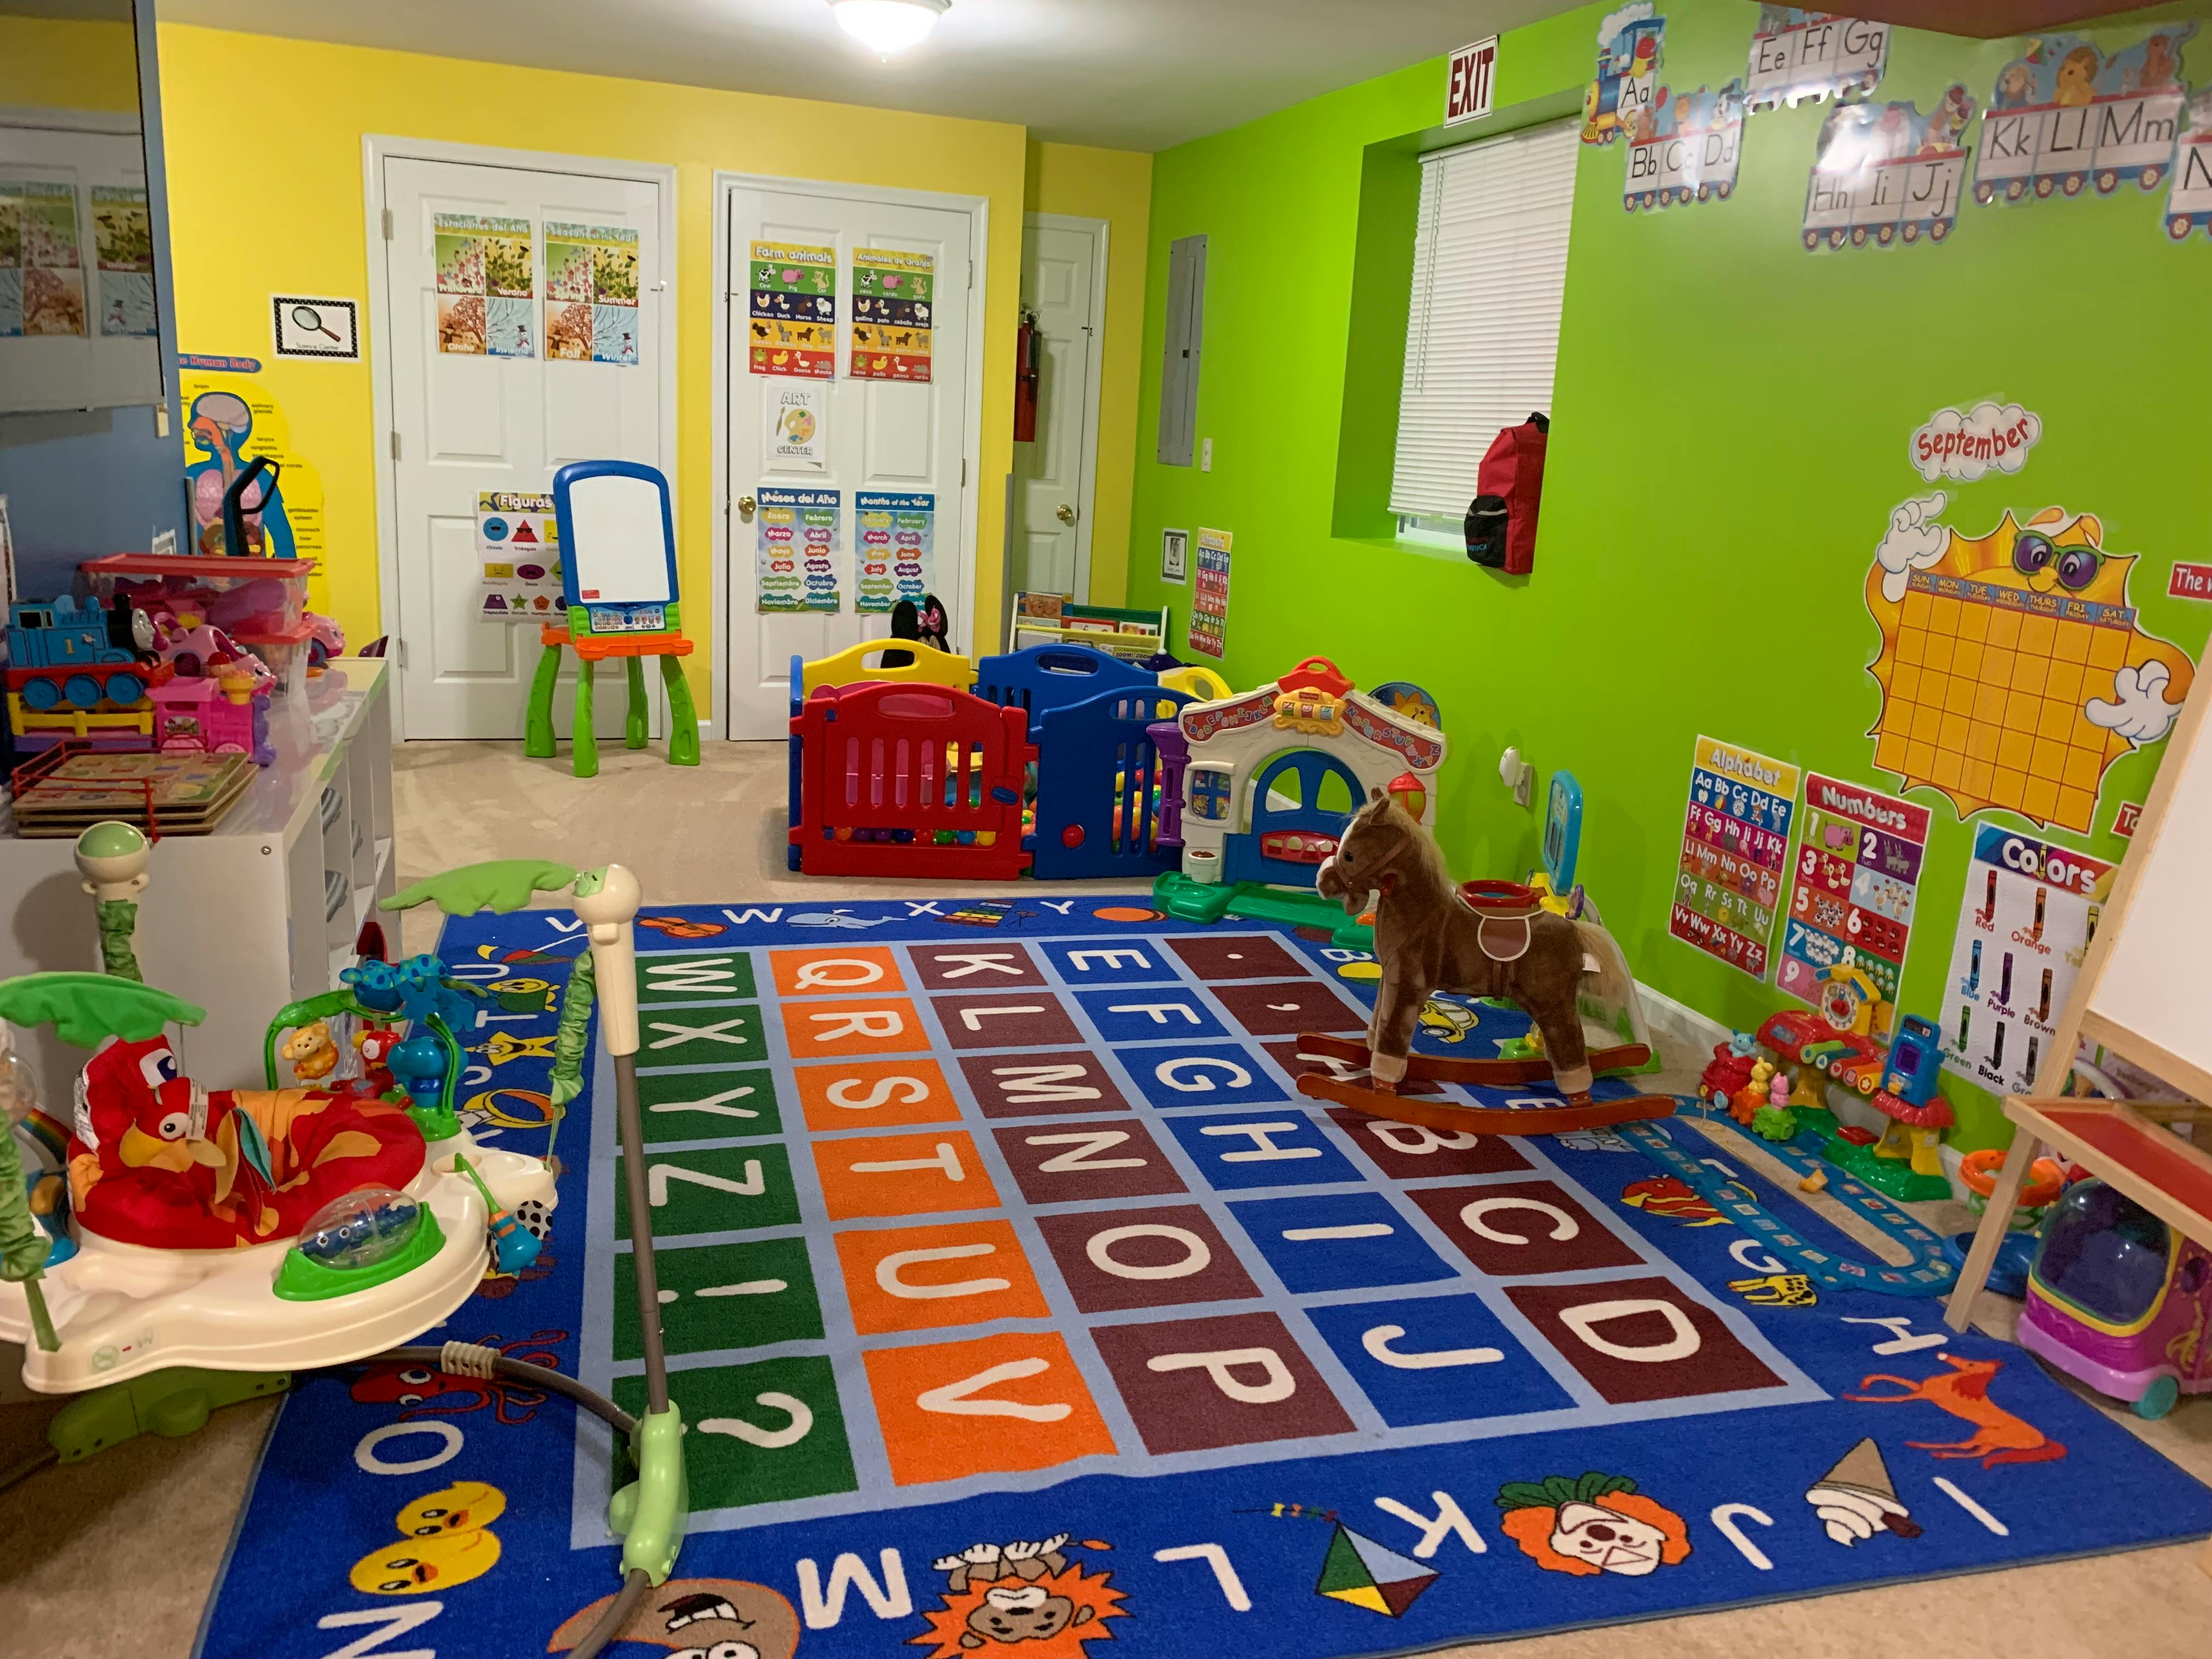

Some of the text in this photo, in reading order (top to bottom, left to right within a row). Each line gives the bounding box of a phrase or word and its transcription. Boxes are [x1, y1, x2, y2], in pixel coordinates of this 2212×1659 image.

[1758, 37, 1785, 73] Ee
[1803, 25, 1832, 65] Ff
[1843, 19, 1883, 68] Gg
[1448, 47, 1494, 119] EXIT
[1621, 77, 1649, 108] Aa
[2101, 100, 2174, 146] Mm
[1705, 133, 1733, 166] Dd
[1990, 118, 2030, 159] Kk
[1631, 147, 1657, 178] Bb
[1814, 179, 1848, 211] Hh
[1912, 162, 1952, 217] Jj
[755, 246, 833, 263] Farm animals
[857, 253, 891, 263] Animales
[906, 258, 930, 268] Granja
[497, 287, 527, 296] Verano
[599, 295, 636, 305] Summer
[191, 357, 227, 368] Human
[229, 358, 256, 371] Body
[560, 348, 580, 359] Fall
[602, 352, 632, 363] Winter
[781, 391, 811, 406] ART
[777, 445, 813, 456] CENTER
[1918, 417, 2028, 462] September
[499, 494, 553, 511] Figuras
[761, 492, 837, 505] Meses del Año
[860, 496, 890, 506] Months
[911, 498, 929, 506] Year
[1912, 574, 1931, 584] SUN
[1939, 579, 1959, 589] MON
[1970, 584, 1987, 594] TUE
[2176, 567, 2203, 591] The
[1999, 590, 2019, 601] WED
[2030, 595, 2057, 607] THURS
[2068, 602, 2086, 612] FRI
[2102, 608, 2125, 618] SAT
[65, 639, 75, 653] 1
[1709, 748, 1781, 786] Alphabet
[1695, 772, 1712, 789] Aa
[1715, 777, 1729, 795] Bb
[1733, 785, 1747, 803] Cc
[1752, 791, 1769, 810] Dd
[1772, 800, 1786, 817] Ee
[1822, 785, 1907, 830] Numbers
[1810, 812, 1820, 837] 1
[1768, 836, 1781, 854] Kk
[1864, 832, 1877, 860] 2
[1802, 851, 1816, 874] 3
[2003, 838, 2096, 895] Colors
[1855, 872, 1871, 896] 4
[1796, 887, 1809, 911] 5
[1847, 908, 1861, 934] 6
[1976, 917, 1994, 932] Red
[1789, 922, 1805, 946] 7
[2011, 931, 2051, 955] Orange
[1068, 949, 1151, 970] E
[1747, 940, 1763, 961] Zz
[1842, 946, 1855, 967] 8
[794, 959, 884, 989] Q
[934, 953, 1024, 979] K
[1785, 960, 1799, 983] 9
[1961, 985, 1980, 1002] Blue
[959, 1006, 1045, 1031] L
[1988, 999, 2015, 1018] Purple
[648, 1018, 747, 1049] X
[809, 1011, 904, 1041] R
[2024, 1014, 2056, 1036] Brown
[1944, 1048, 1972, 1070] Green
[991, 1065, 1102, 1103] M
[1155, 1057, 1252, 1092] G
[1979, 1065, 2005, 1086] Black
[826, 1076, 929, 1109] S
[1025, 1131, 1147, 1173] N
[1200, 1122, 1322, 1163] H
[849, 1143, 965, 1181] T
[648, 1160, 765, 1207] Z
[1460, 1198, 1579, 1245] C
[1086, 1224, 1210, 1280] O
[876, 1244, 1011, 1299] U
[1558, 1298, 1701, 1362] D
[1362, 1325, 1505, 1369] J
[1147, 1347, 1296, 1404] P
[917, 1358, 1071, 1421] V
[1374, 1491, 1487, 1559] K
[797, 1548, 913, 1629] M
[1153, 1543, 1252, 1612] L
